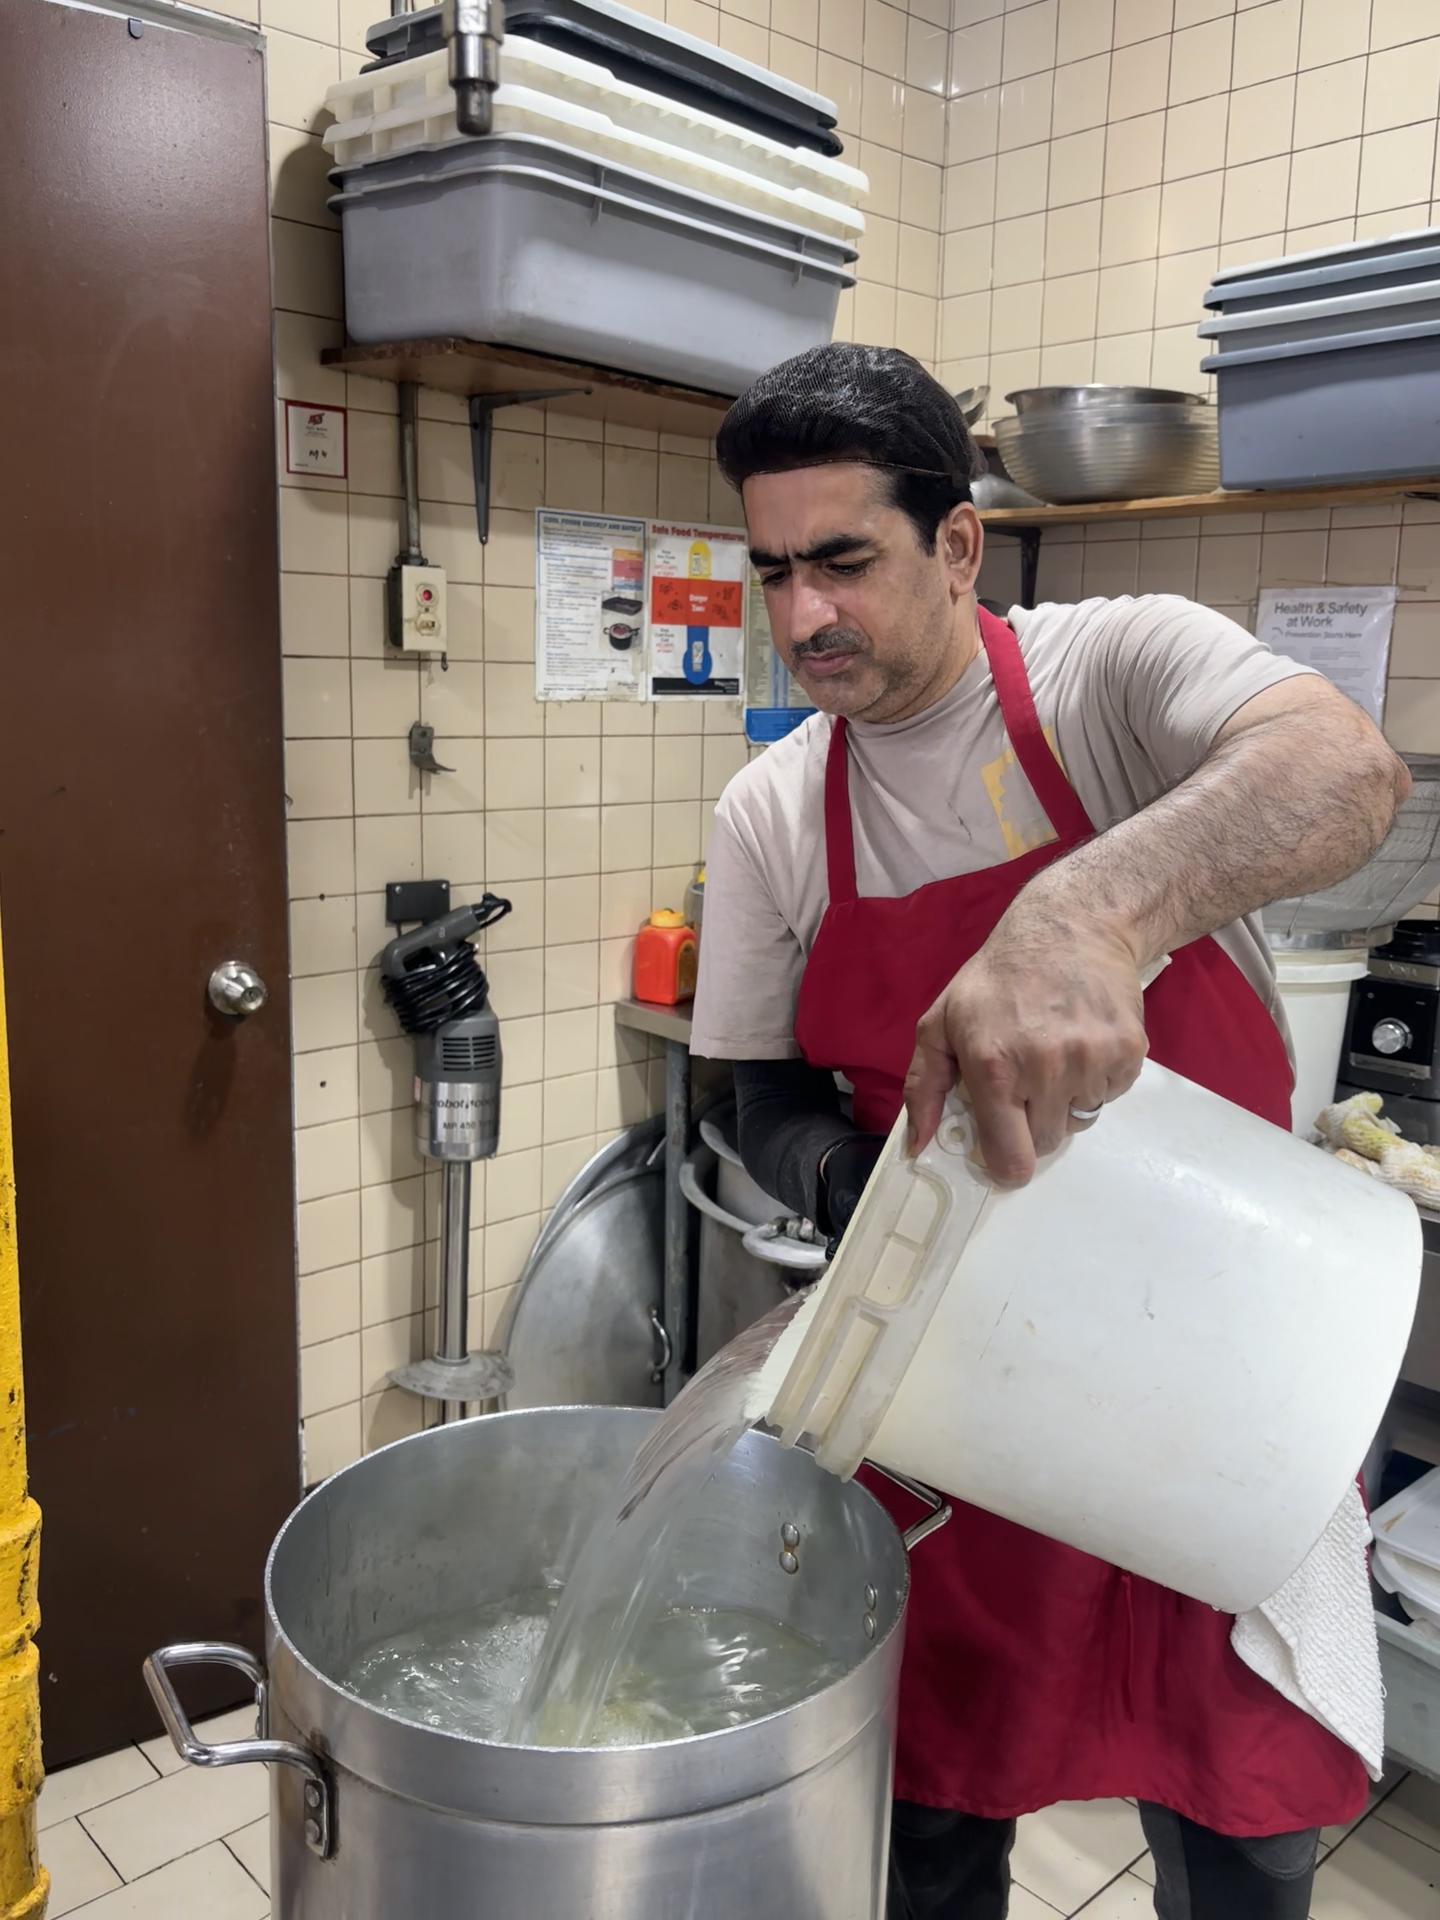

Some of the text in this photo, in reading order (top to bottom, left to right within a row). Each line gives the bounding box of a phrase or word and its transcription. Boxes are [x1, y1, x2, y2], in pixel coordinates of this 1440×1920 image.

[652, 525, 669, 534] Safe
[671, 527, 692, 537] Food
[1274, 602, 1368, 617] Health & Safety
[1286, 616, 1333, 628] at Work
